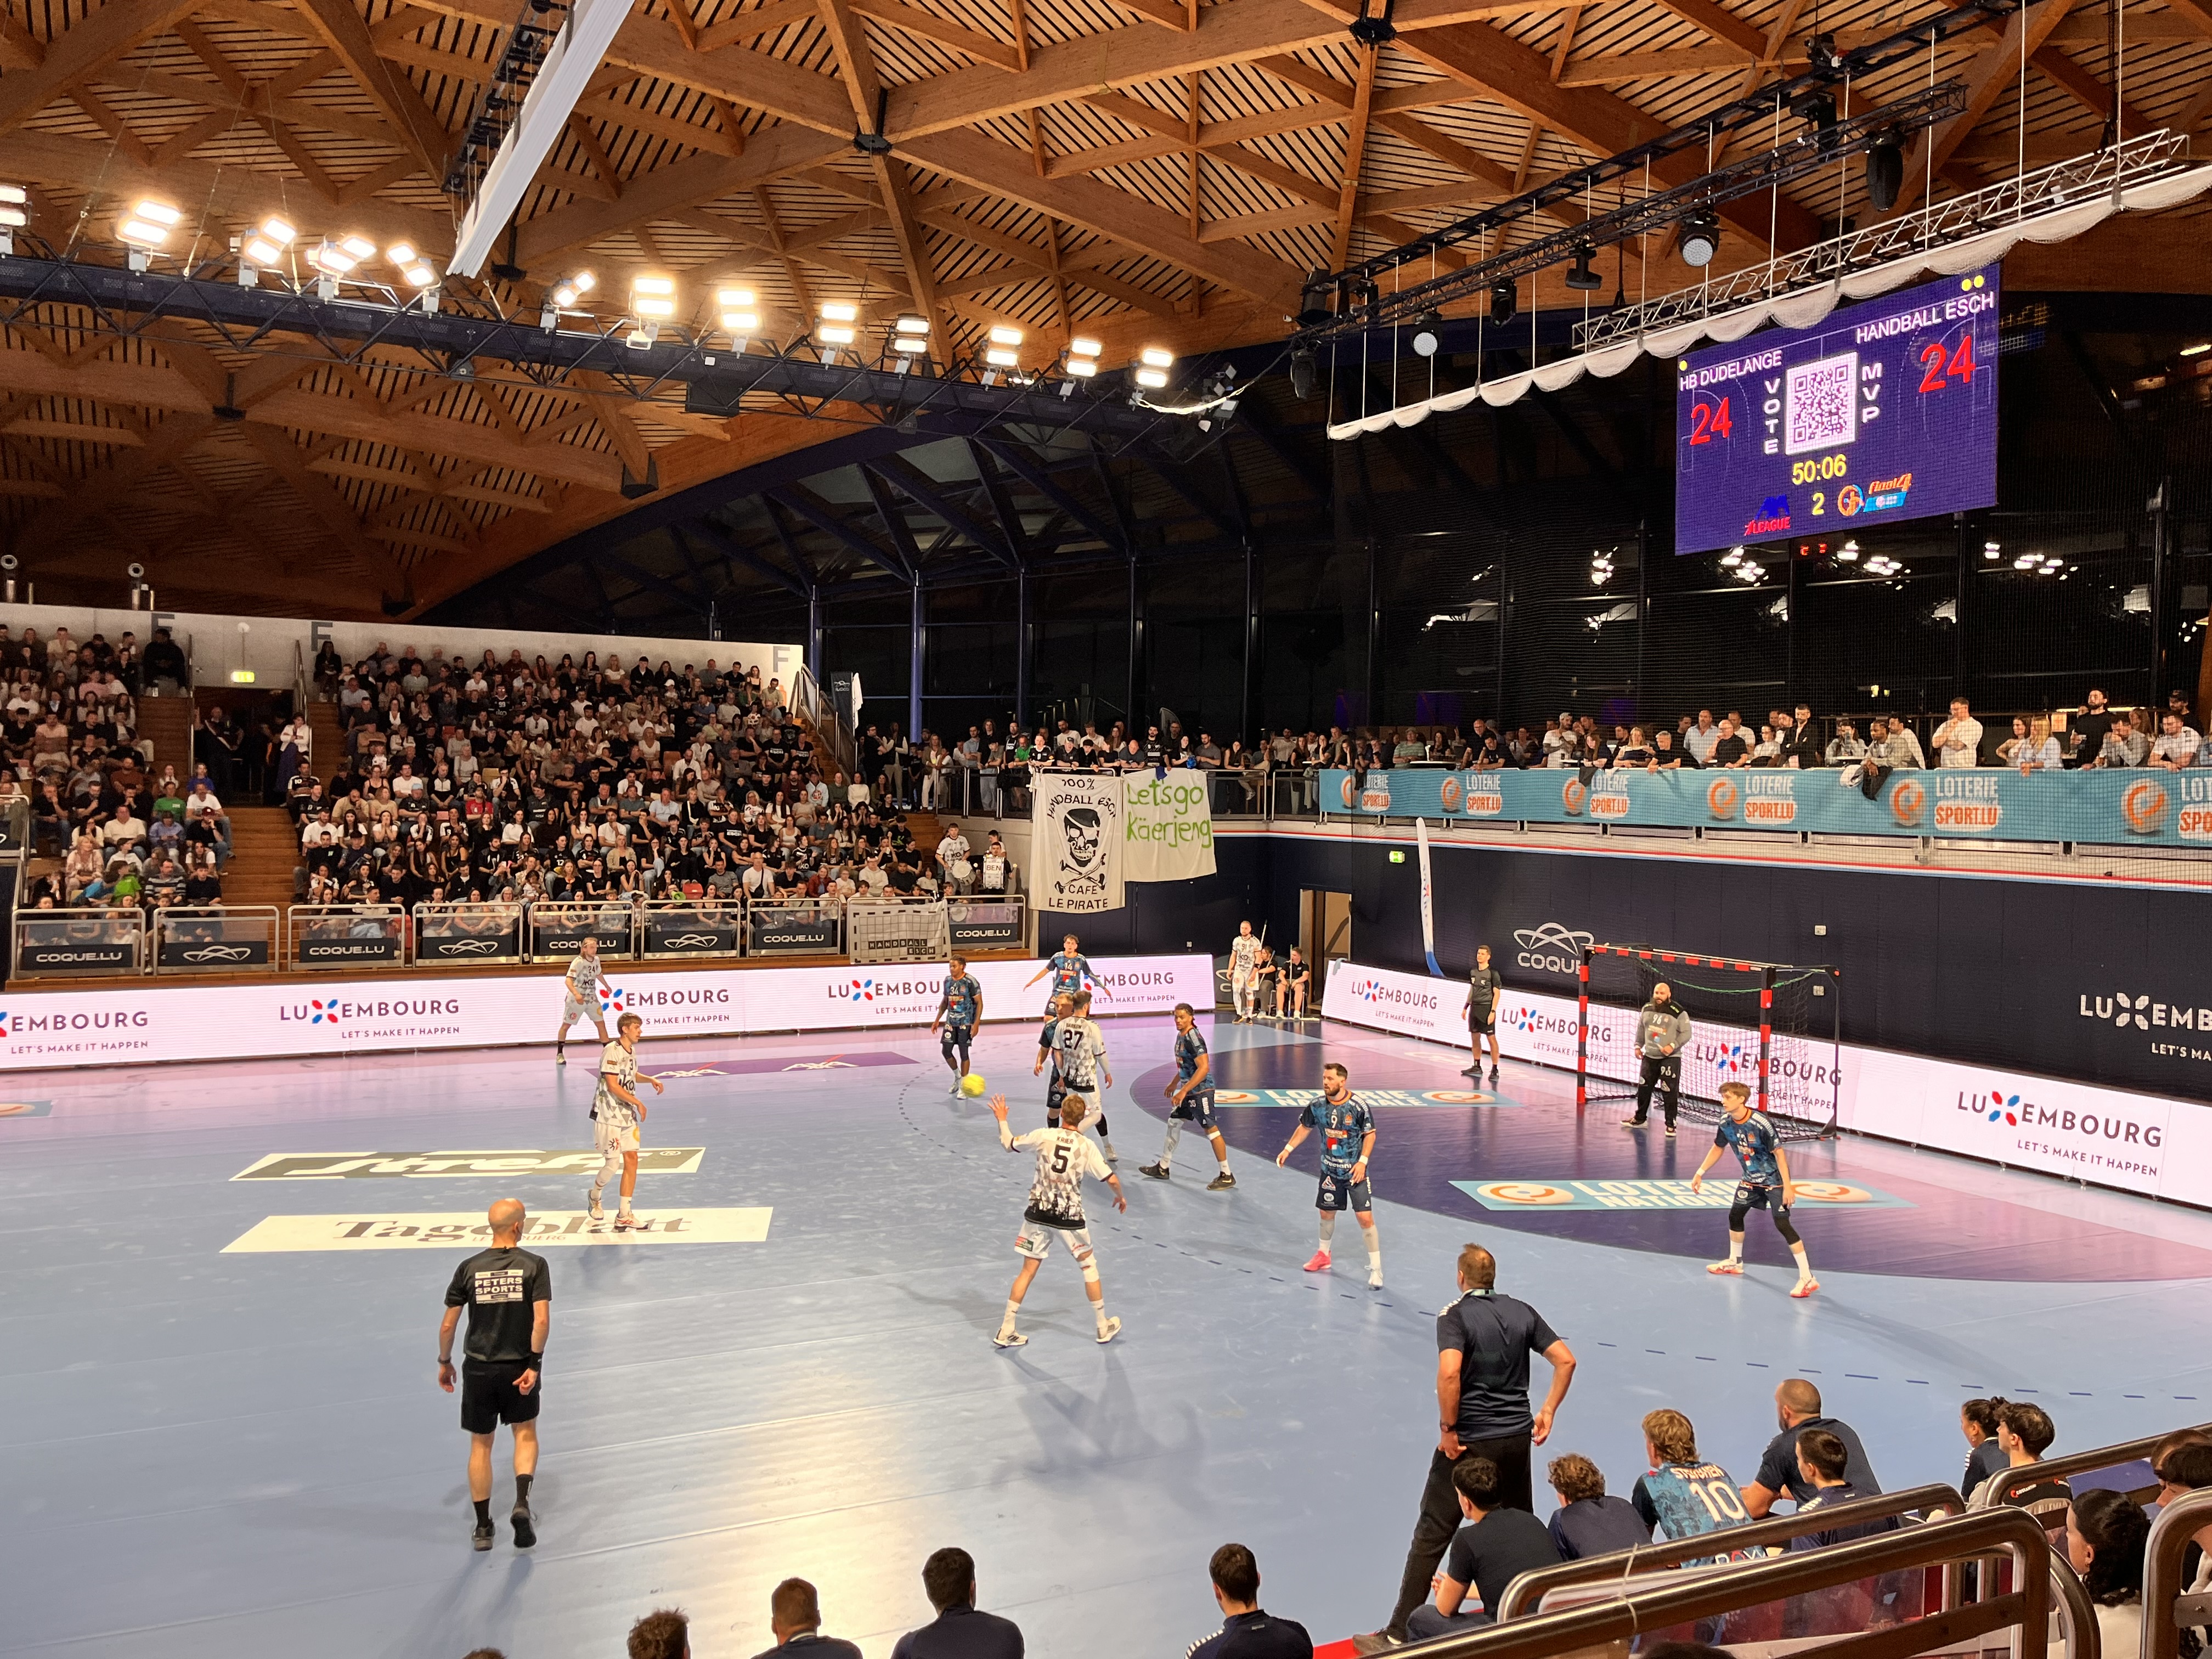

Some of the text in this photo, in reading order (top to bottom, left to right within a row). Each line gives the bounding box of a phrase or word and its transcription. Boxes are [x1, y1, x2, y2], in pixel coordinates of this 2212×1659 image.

[1856, 291, 1995, 344] HANDBALL ESCH
[1680, 350, 1782, 391] HB DUDELANGE
[1919, 335, 1976, 394] 24
[1690, 397, 1733, 445] 24
[1792, 454, 1847, 485] 50:06
[1812, 492, 1825, 516] 2
[311, 621, 333, 651] F
[772, 646, 791, 673] F
[1062, 778, 1095, 791] 100%
[1364, 774, 1389, 789] OTERIE
[1466, 774, 1501, 790] LOTERIE
[1592, 774, 1630, 792] LOTERIE
[1745, 775, 1795, 794] LOTERIE
[1936, 776, 1999, 798] LOTERIE
[1047, 794, 1116, 819] HANDBALL ESCH
[1362, 794, 1389, 808] SPORT.LU
[1467, 797, 1502, 811] SPORT.LU
[1590, 798, 1628, 814] SPORT.LU
[1745, 802, 1795, 819] SPORT.LU
[1936, 806, 1998, 825] SPORT.LU
[1127, 811, 1212, 849] Käerjeng
[1068, 884, 1098, 895] CAFE
[1049, 898, 1108, 910] LE PIRATE
[763, 934, 825, 944] COQUE.LU
[956, 929, 1011, 938] COQUE.LU
[309, 945, 385, 956] COQUE.LU
[549, 940, 617, 949] COQ.LU
[870, 939, 926, 949] HANDBALL
[36, 952, 123, 963] COQUE.LU
[828, 979, 941, 1001] LUXEMBOU
[1351, 980, 1437, 1010] LUXEMBOURG
[600, 989, 730, 1012] XEMBOURG
[280, 999, 459, 1024] LUXEMBOURG
[654, 1017, 679, 1025] MAKE
[694, 1014, 730, 1023] HAPPEN
[1375, 1010, 1389, 1019] LET'S
[1390, 1013, 1405, 1022] MAKE
[1413, 1018, 1435, 1028] HAPPEN
[1652, 1014, 1662, 1025] 96
[2080, 992, 2212, 1031] LUXEMB
[342, 1026, 460, 1039] LET'S MAKE IT HAPPEN
[1063, 1029, 1084, 1050] 27
[11, 1045, 43, 1054] LET'S
[48, 1043, 81, 1053] MAKE
[101, 1041, 149, 1050] HAPPEN
[1533, 1042, 1609, 1063] LET'S MAKE IT APPEN
[2151, 1042, 2212, 1062] LET'S MA
[652, 1068, 730, 1078] AXA
[782, 1060, 859, 1071] AXA
[1660, 1066, 1671, 1076] 96
[1265, 1090, 1417, 1099] LORIE
[1768, 1090, 1787, 1101] AKE
[1331, 1115, 1338, 1128] 9
[1957, 1090, 2162, 1148] LUXEMBOURG
[1057, 1136, 1074, 1145] KRIER
[1051, 1144, 1071, 1174] 5
[2017, 1139, 2158, 1177] LET'S MAKE IT HAPPEN
[1600, 1195, 1734, 1207] NATION
[475, 1277, 523, 1288] PETERS
[475, 1285, 523, 1295] SPORTS
[1689, 1481, 1745, 1523] 10
